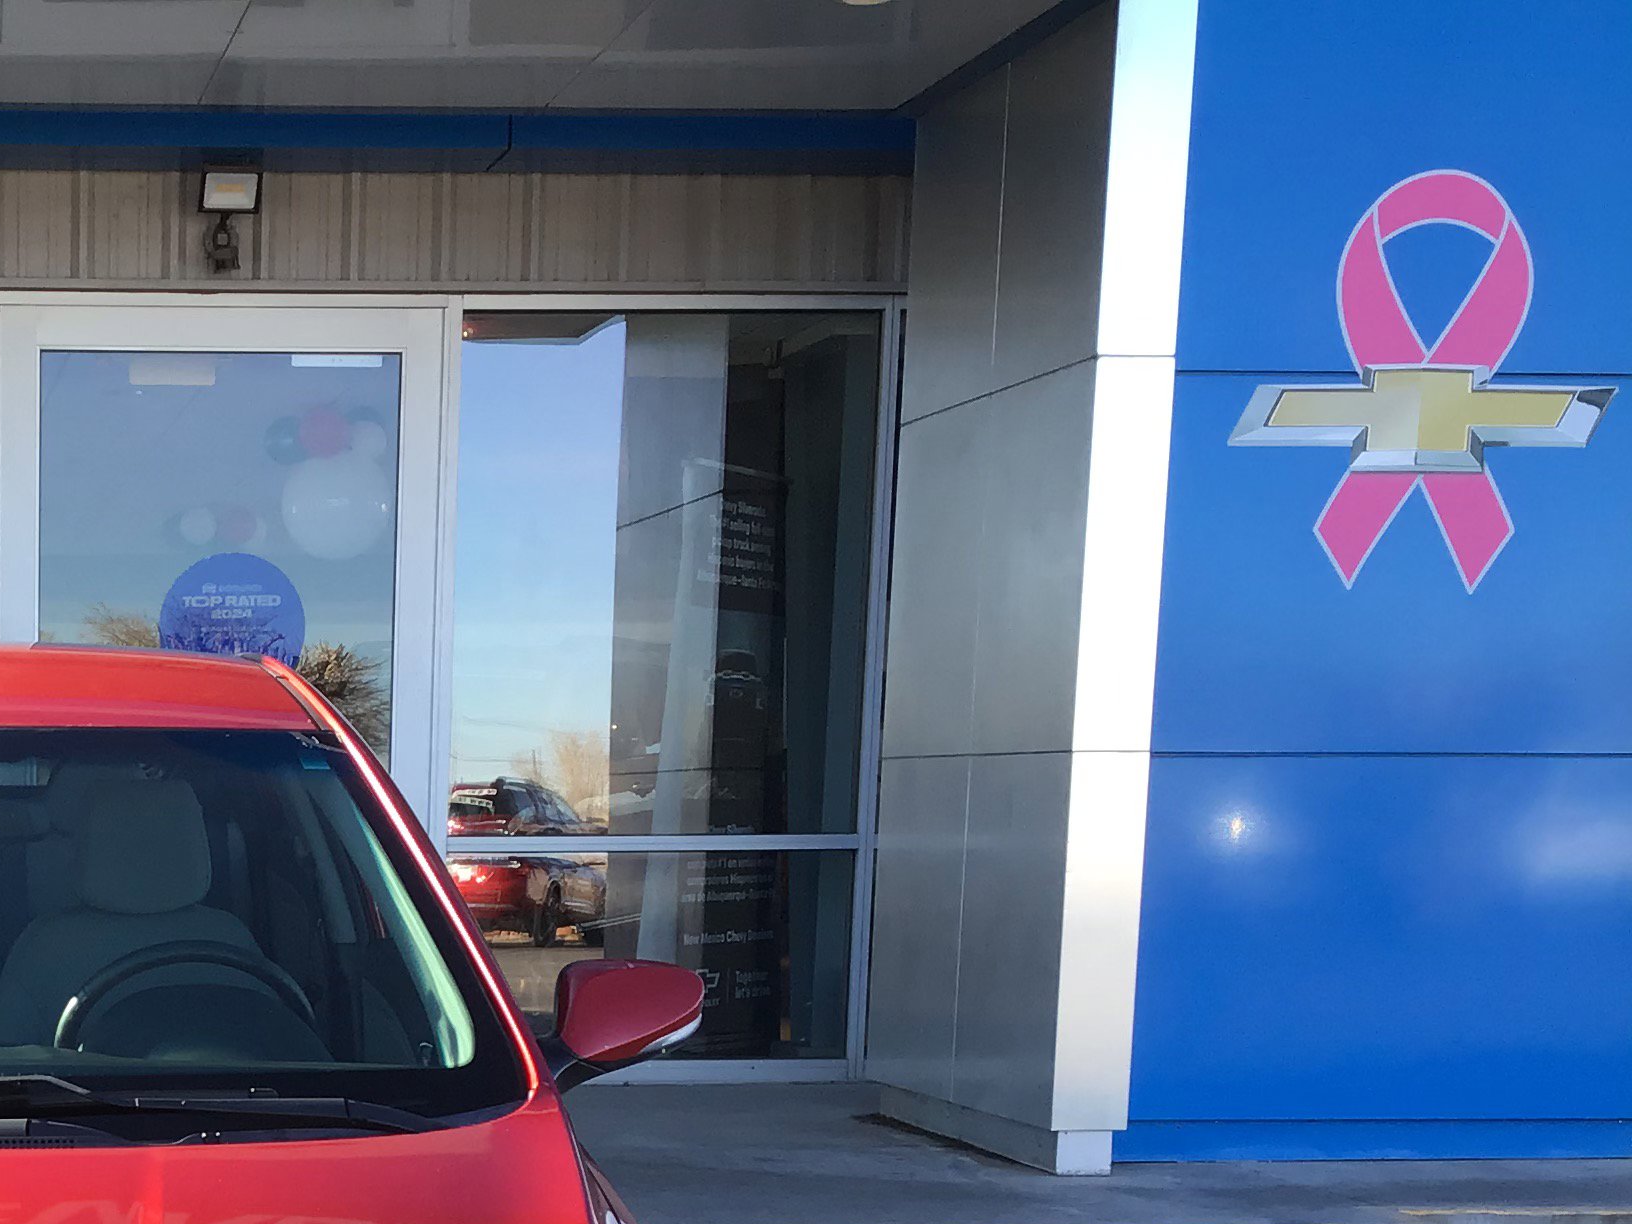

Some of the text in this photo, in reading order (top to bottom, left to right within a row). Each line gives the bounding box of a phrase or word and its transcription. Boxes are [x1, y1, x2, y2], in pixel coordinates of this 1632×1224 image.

[182, 595, 282, 608] TOP RATED
[211, 609, 252, 619] 2024
